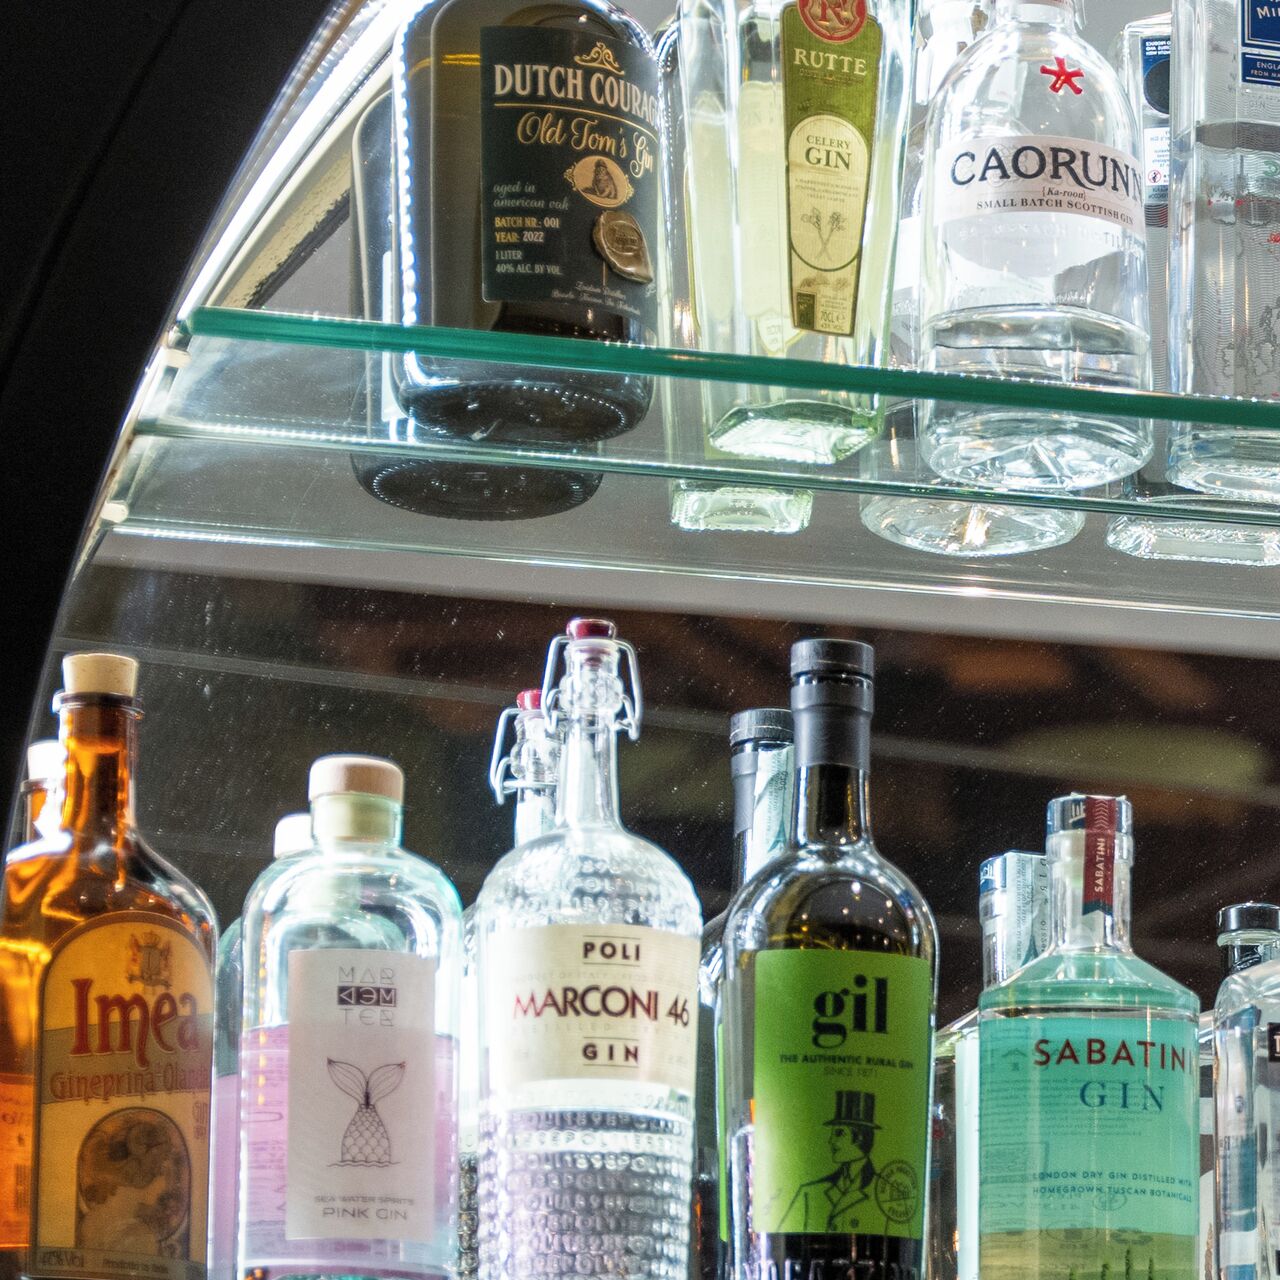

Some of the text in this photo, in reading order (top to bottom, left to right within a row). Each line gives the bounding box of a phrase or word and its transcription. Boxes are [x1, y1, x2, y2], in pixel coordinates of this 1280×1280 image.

[793, 49, 866, 75] RUTTE
[494, 64, 583, 100] DUTCH
[517, 112, 627, 159] Old Tom's
[807, 135, 850, 149] CELERY
[804, 148, 851, 170] GIN
[977, 199, 1119, 218] SMALL BATCH SCOTTISH
[523, 231, 544, 242] 2022
[583, 942, 640, 961] POLI
[514, 985, 689, 1028] MARCONI 46
[812, 974, 888, 1049] gil
[70, 978, 200, 1070] Imea
[582, 1043, 639, 1062] GIN
[802, 1054, 862, 1065] AUTHENTIC
[1079, 1082, 1164, 1112] GIN
[1107, 1187, 1146, 1195] TUSCAN
[322, 1208, 369, 1219] PINK
